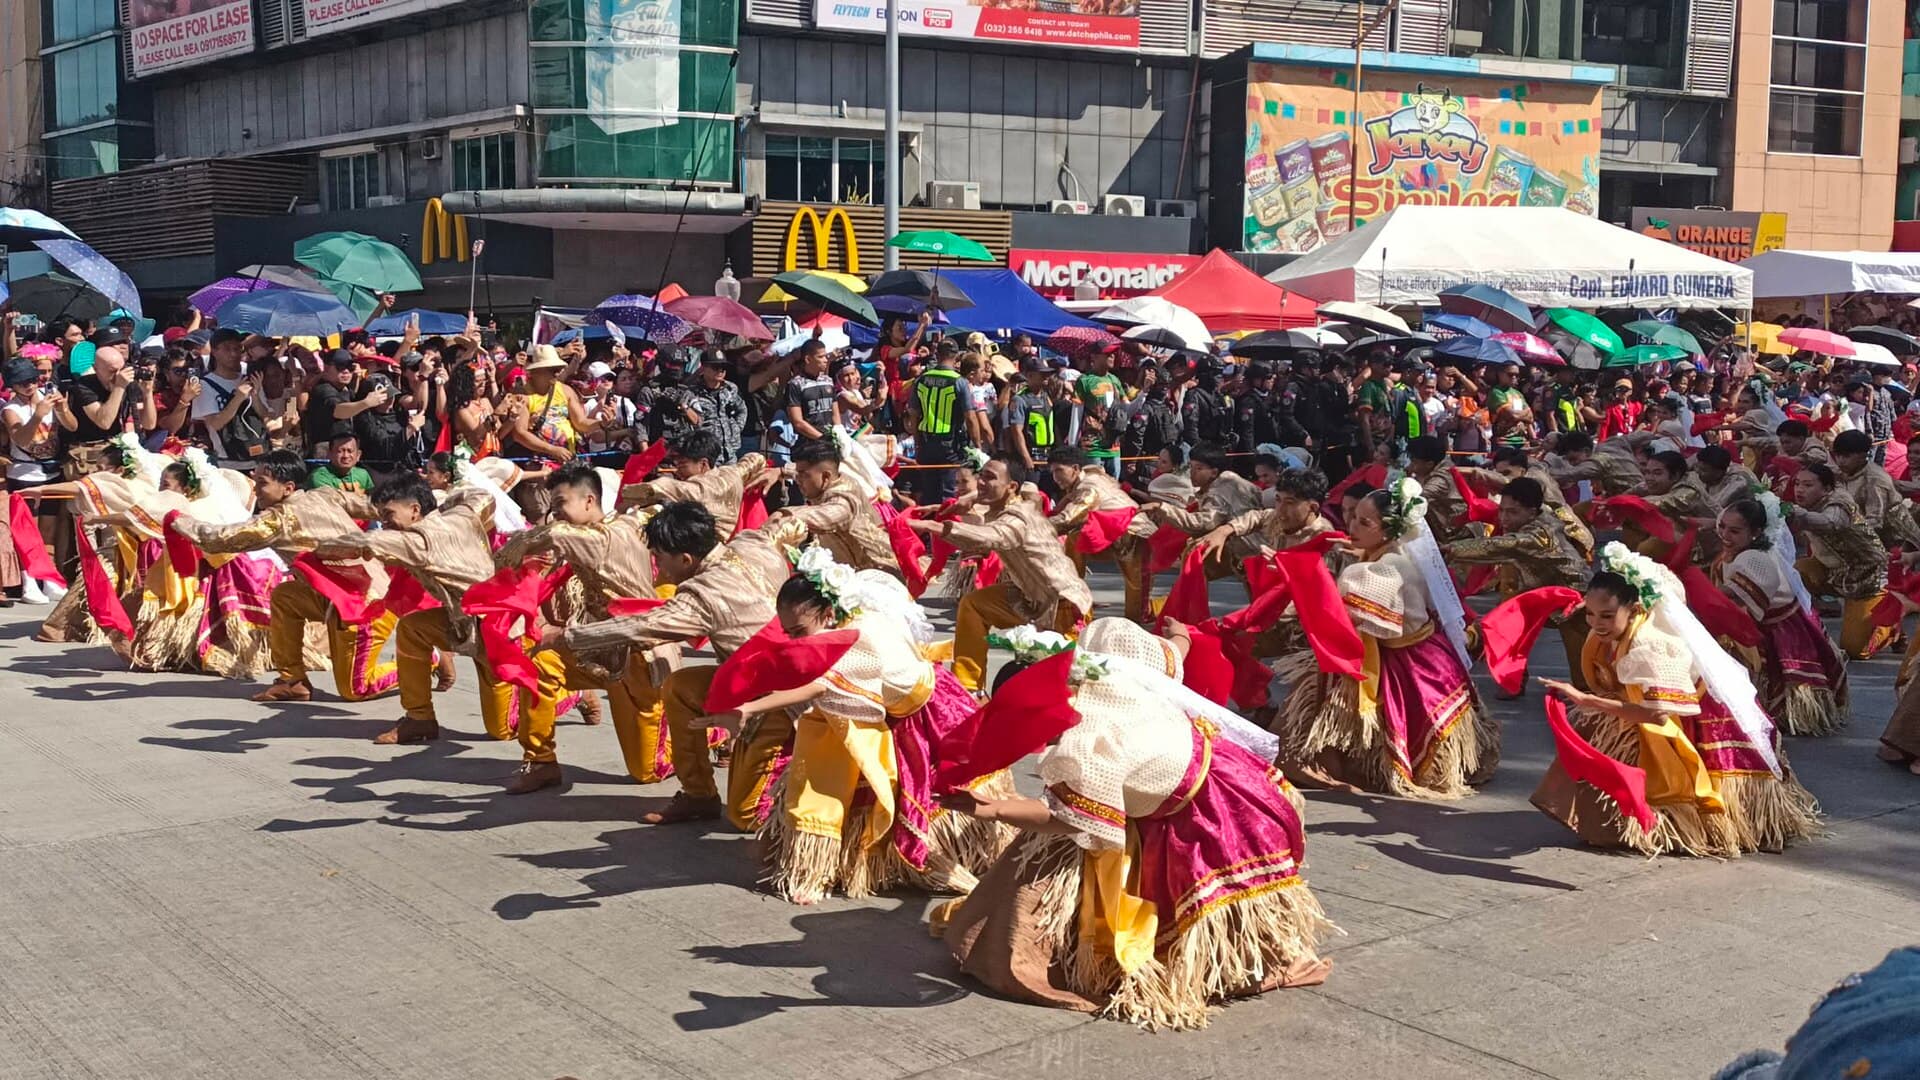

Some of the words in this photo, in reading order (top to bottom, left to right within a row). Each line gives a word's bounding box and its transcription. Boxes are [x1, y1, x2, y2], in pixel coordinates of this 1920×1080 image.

[309, 2, 343, 20] PLEASE
[833, 4, 870, 17] FLYTECH
[135, 31, 148, 50] AD
[149, 22, 184, 47] SPACE
[185, 16, 208, 37] FOR
[210, 5, 250, 32] LEASE
[984, 23, 1006, 33] (032)
[139, 50, 163, 65] PLEASE
[165, 46, 183, 60] CALL
[184, 41, 199, 56] BEA
[1365, 117, 1488, 175] Jersey
[1677, 225, 1752, 244] ORANGE
[1570, 275, 1605, 300] Capt.
[1611, 275, 1669, 298] EDUARD
[1674, 274, 1735, 298] GUMERA
